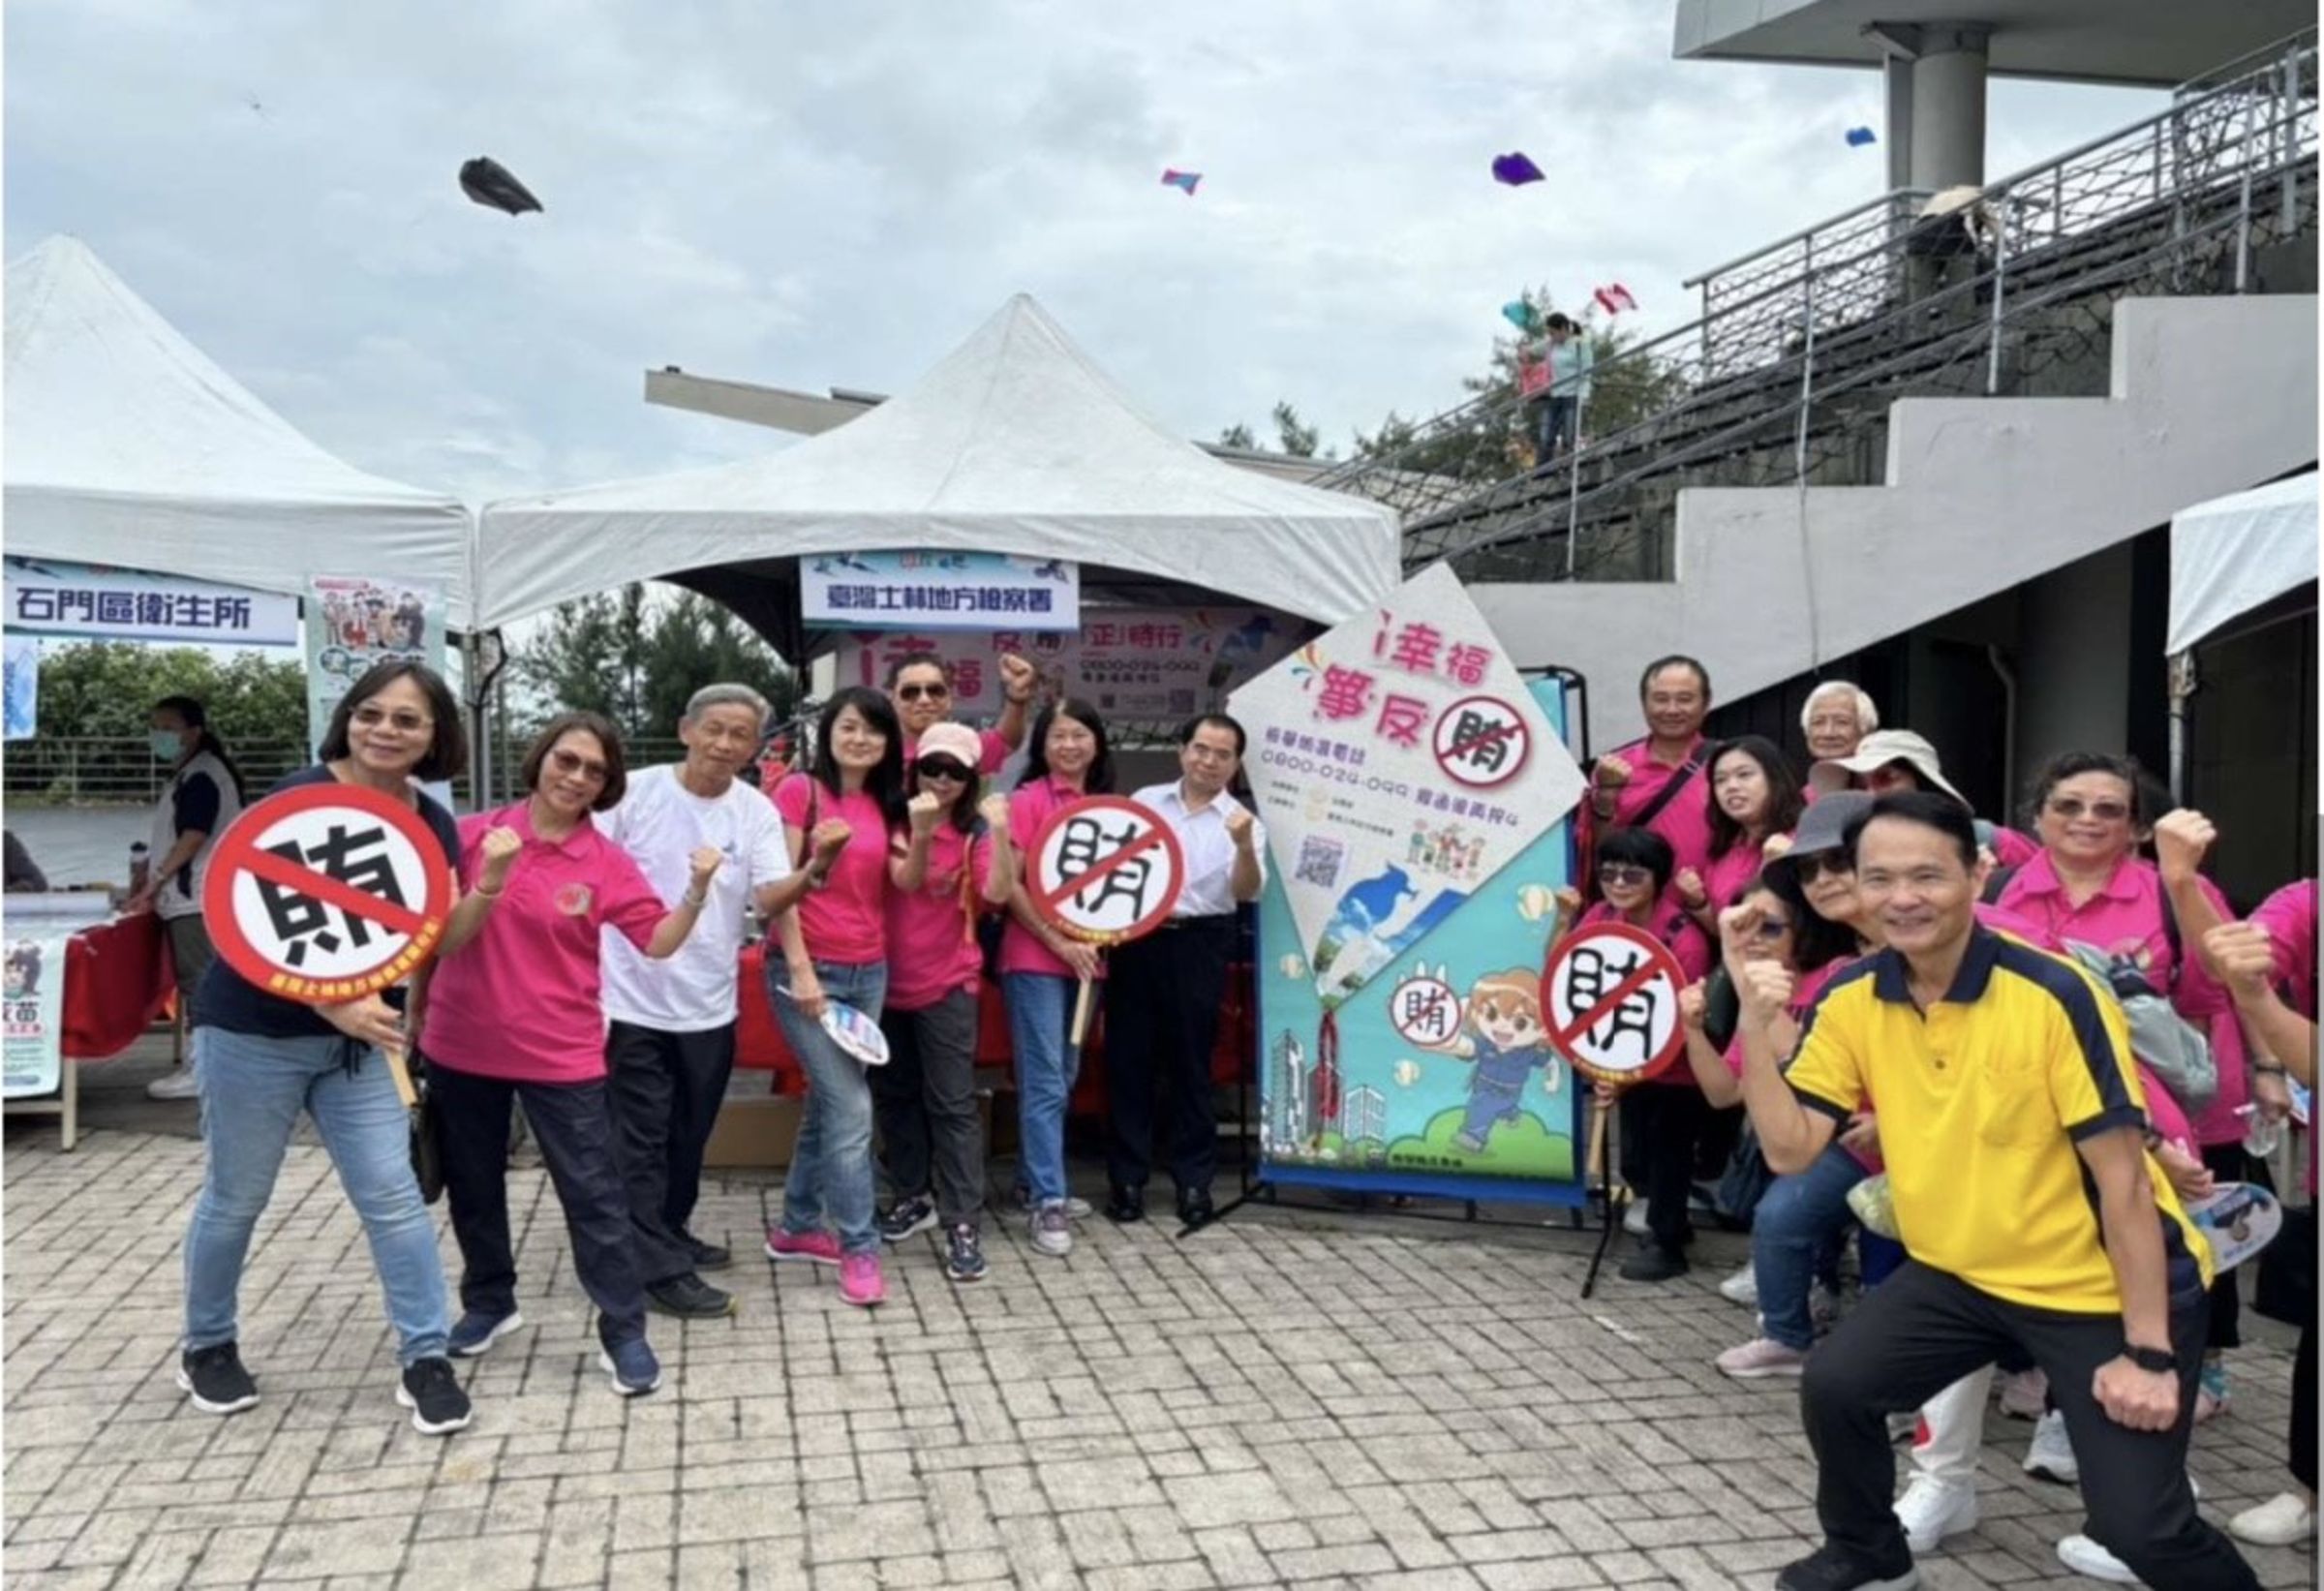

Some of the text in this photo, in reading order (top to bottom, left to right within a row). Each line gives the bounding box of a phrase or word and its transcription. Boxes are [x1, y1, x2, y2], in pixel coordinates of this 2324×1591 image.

[16, 587, 251, 629] 石門區衛生所
[827, 584, 1053, 613] 臺灣士林地方檢察署
[254, 825, 408, 966] 賄
[1056, 817, 1160, 922] 賄
[1405, 987, 1448, 1037] 賄
[1567, 947, 1663, 1059] 賄
